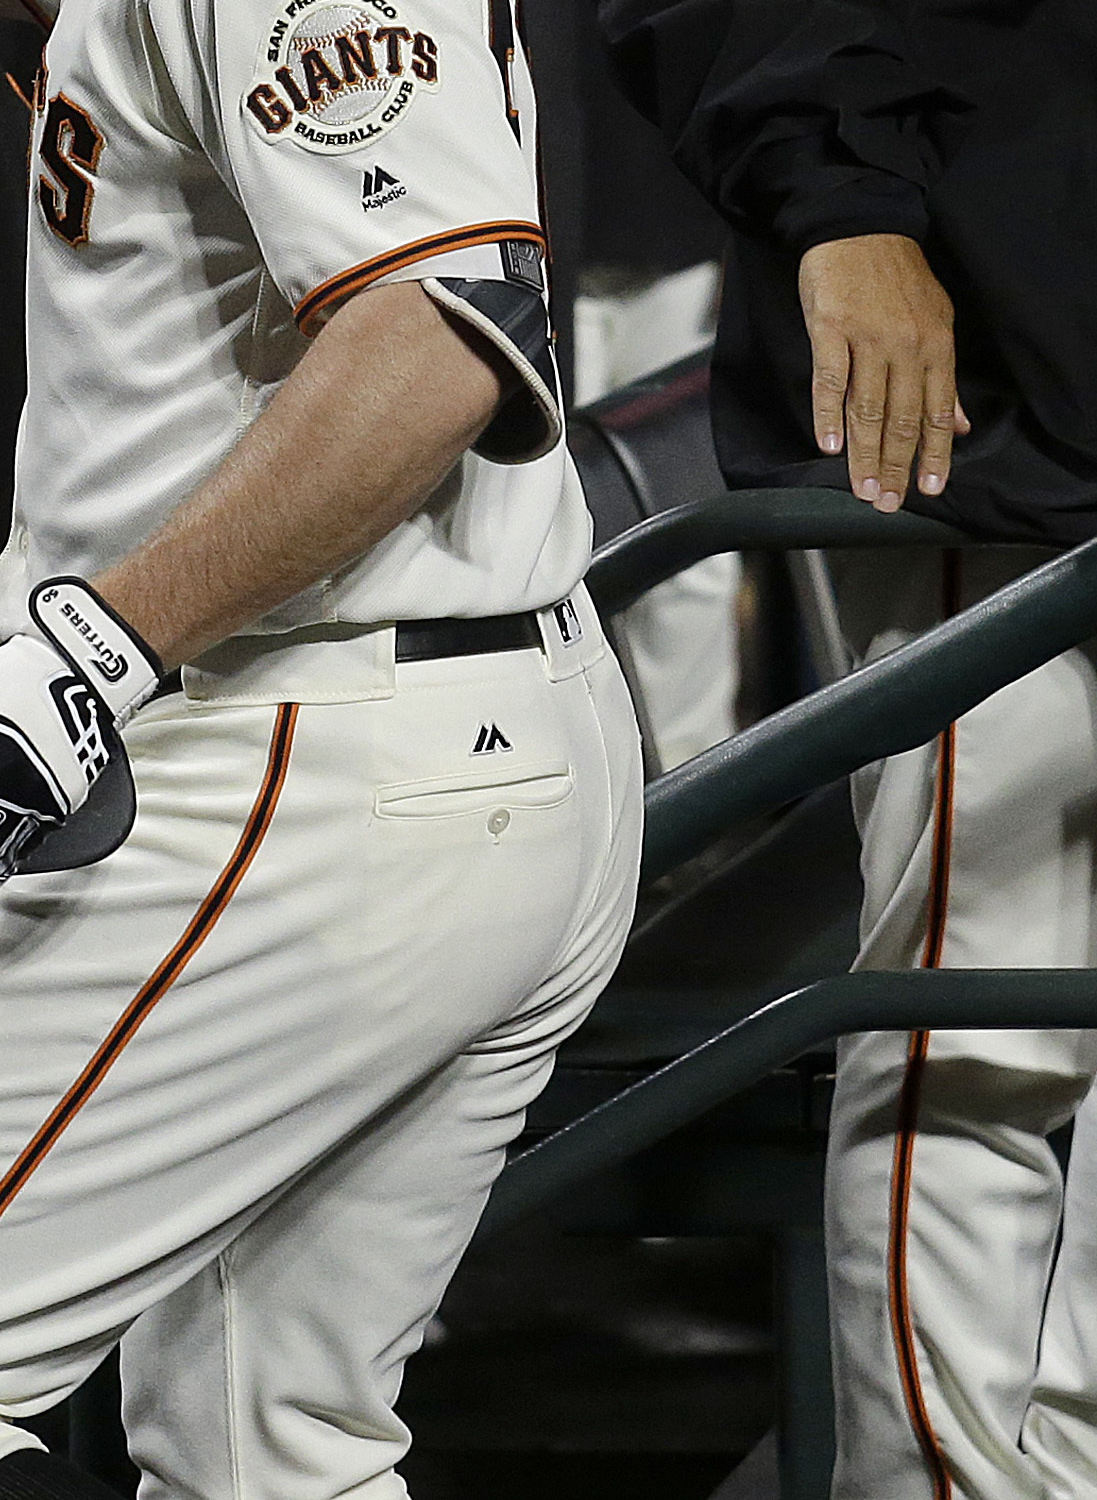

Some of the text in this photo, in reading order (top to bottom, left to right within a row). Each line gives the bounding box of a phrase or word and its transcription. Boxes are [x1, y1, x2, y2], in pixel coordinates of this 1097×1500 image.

[267, 19, 289, 62] SAN
[246, 26, 438, 134] GIANTS
[294, 80, 414, 145] BASEBALL CLUB
[361, 186, 407, 213] Majestic
